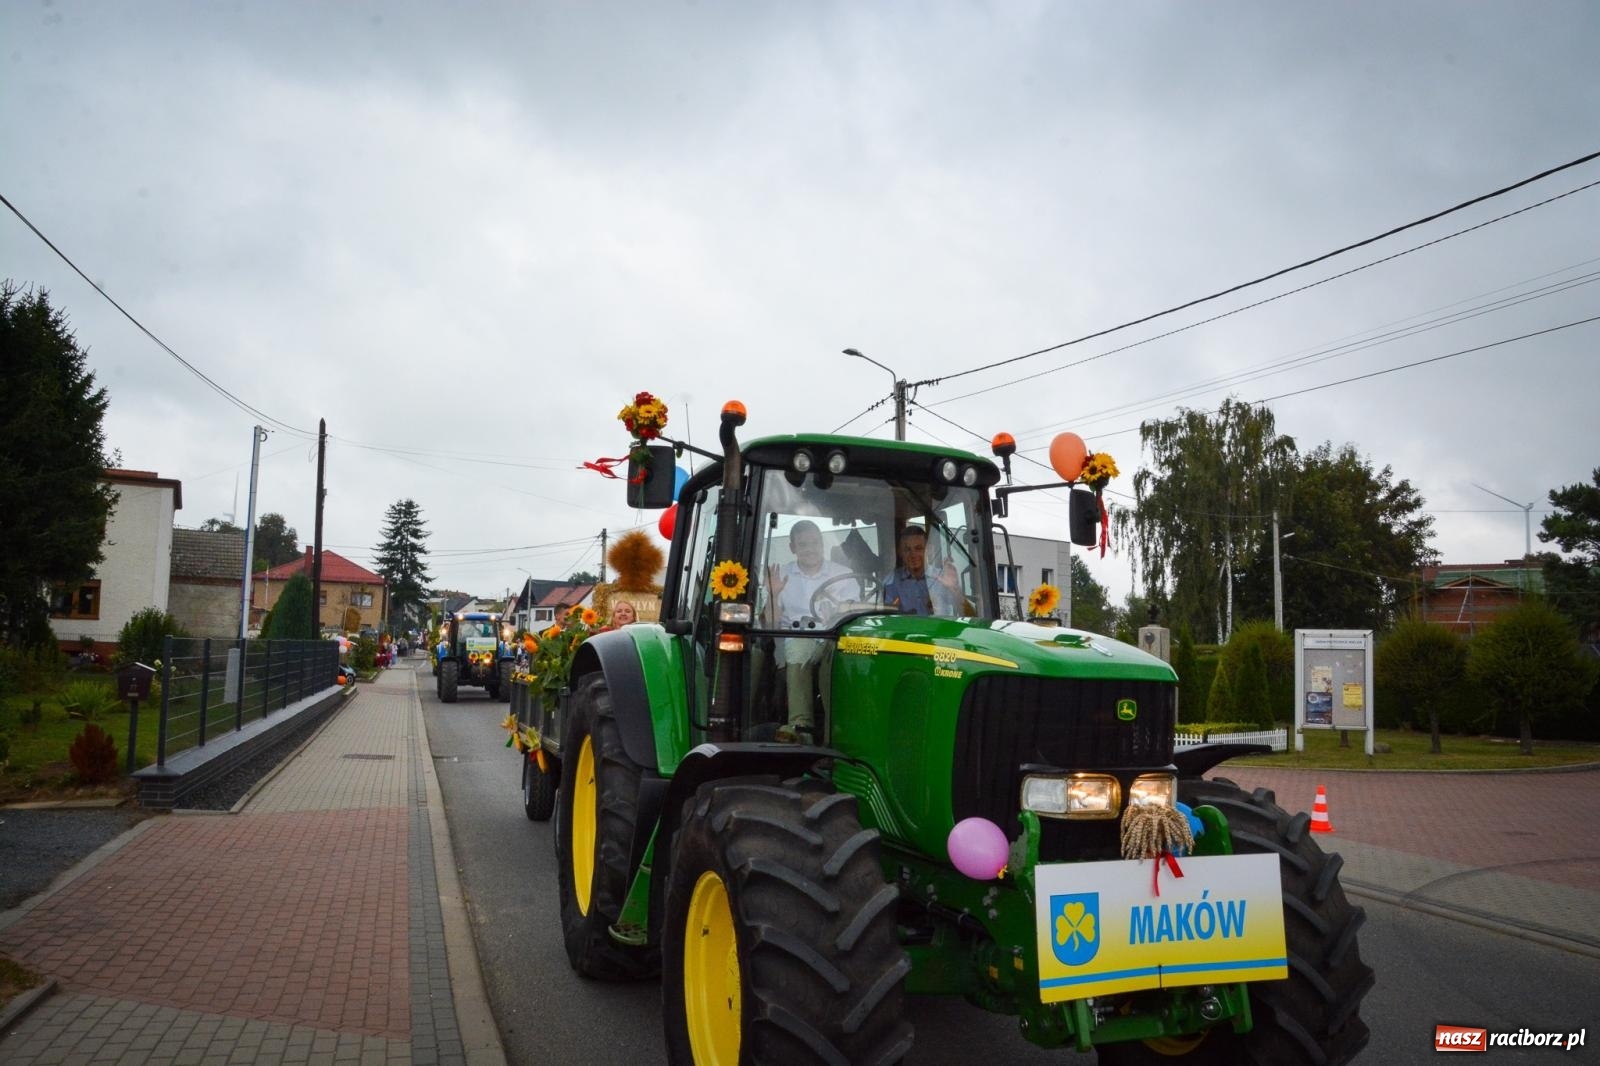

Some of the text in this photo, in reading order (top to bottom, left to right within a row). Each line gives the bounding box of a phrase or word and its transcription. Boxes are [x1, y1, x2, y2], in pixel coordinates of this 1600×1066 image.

[933, 650, 956, 663] 6820
[940, 667, 963, 679] KRONE
[1129, 889, 1247, 945] MAKÓW
